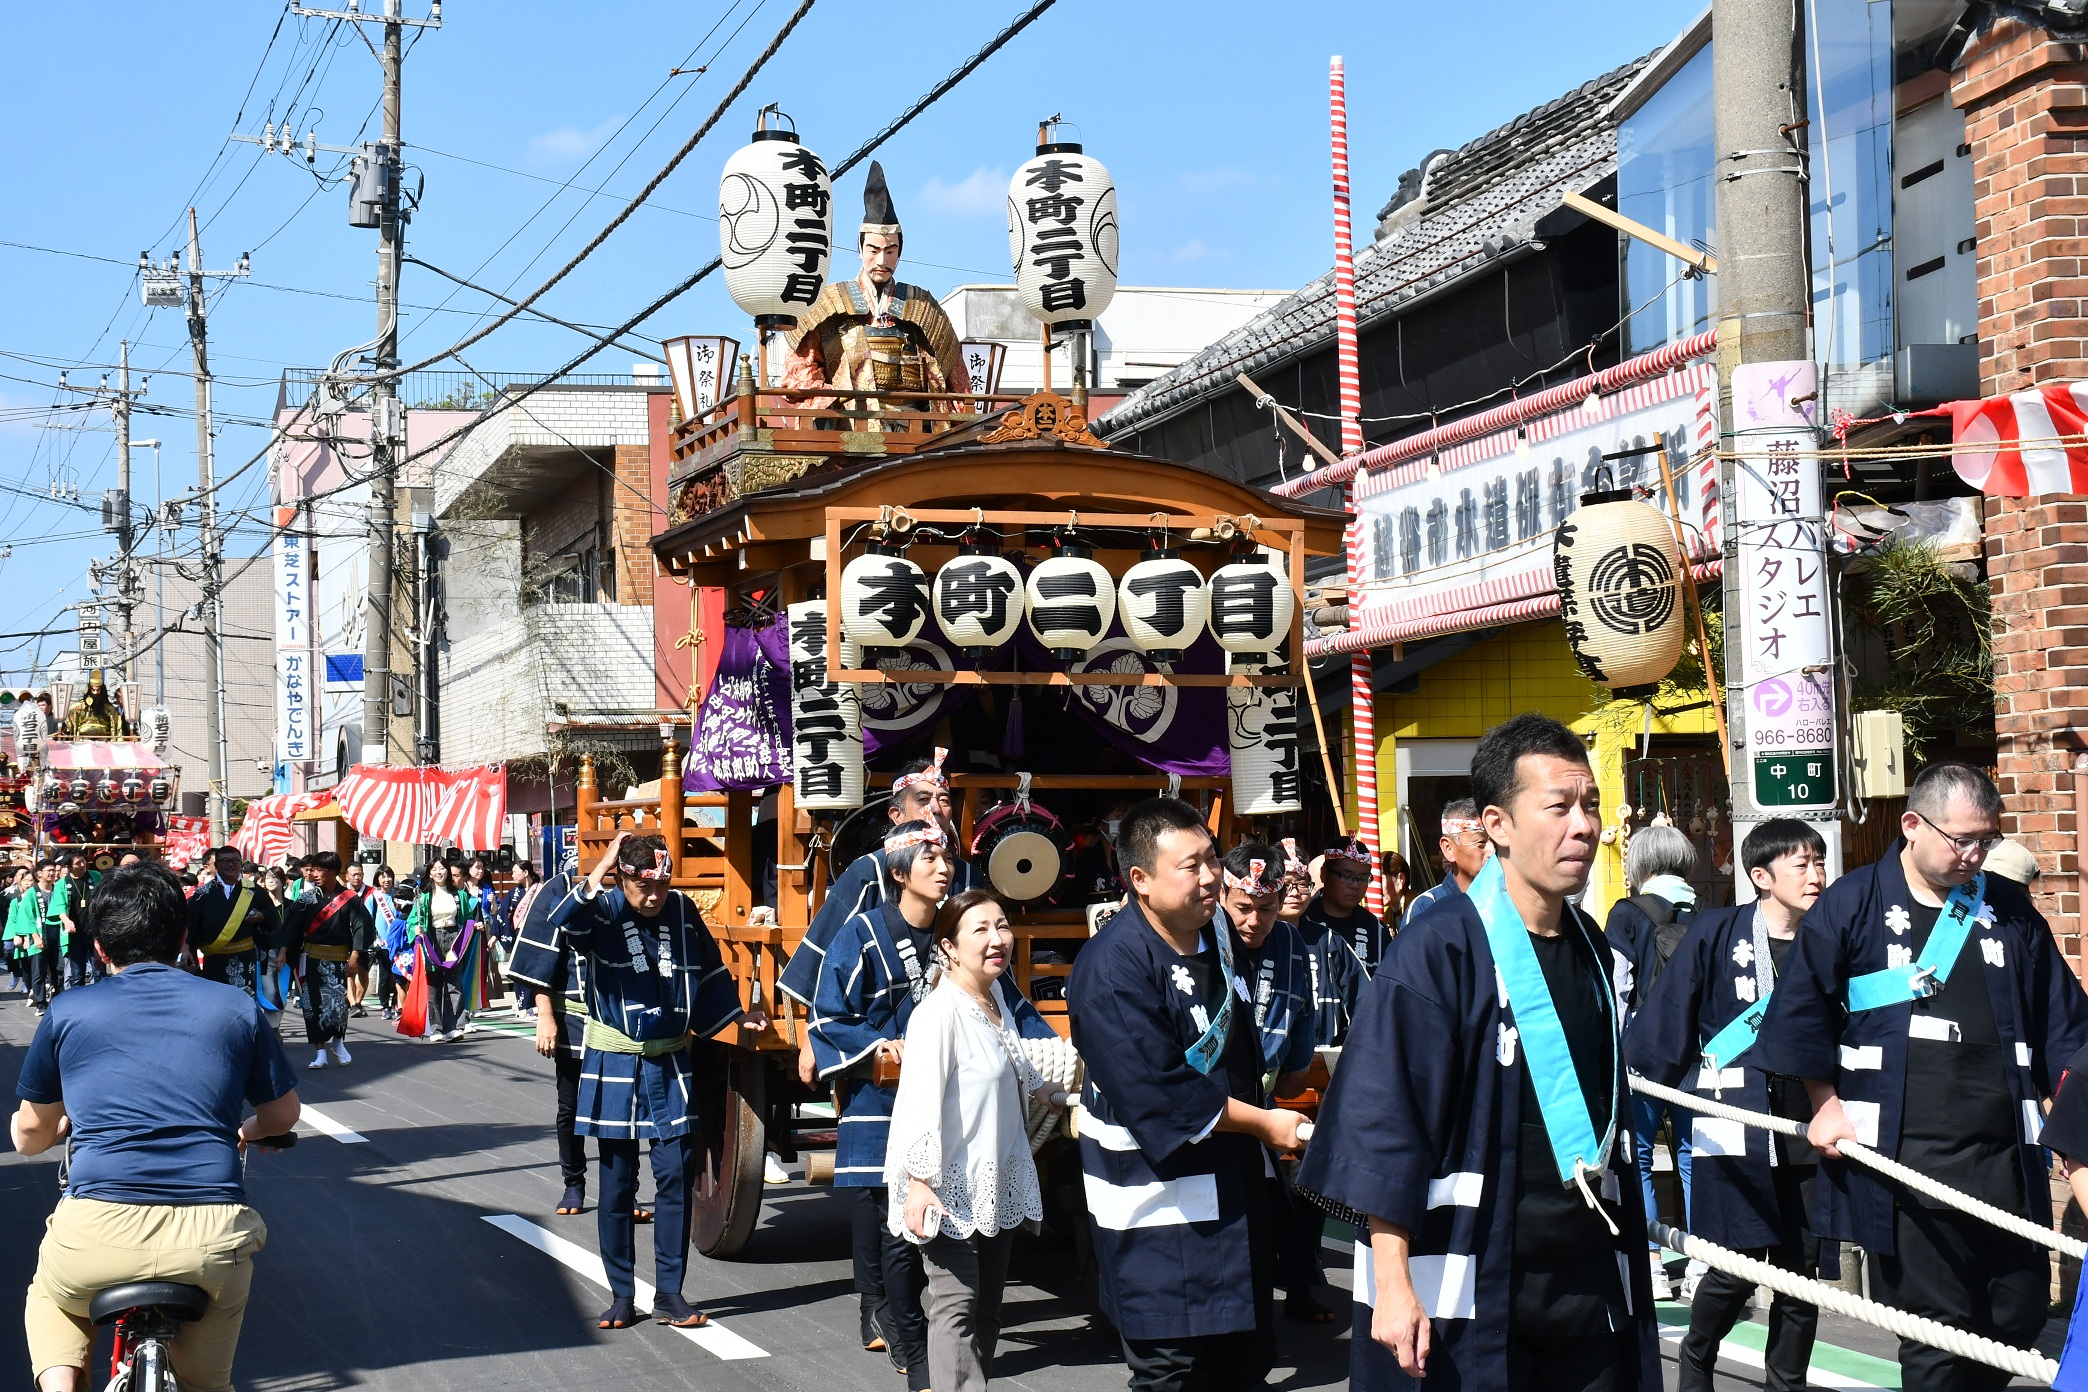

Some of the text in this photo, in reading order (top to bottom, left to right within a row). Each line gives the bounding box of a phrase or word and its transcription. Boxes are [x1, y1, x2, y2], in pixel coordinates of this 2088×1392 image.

[777, 148, 830, 306] 本町二丁目
[1025, 159, 1085, 312] 本町二丁目
[696, 344, 715, 408] 御祭礼
[1767, 440, 1821, 618] 藤沼バレエ
[283, 536, 301, 640] 東芝ストアー
[857, 560, 1278, 639] 本町二丁目
[1755, 523, 1787, 659] スタジオ
[286, 655, 304, 758] かなやでんき
[1796, 680, 1830, 695] 40m先
[1797, 697, 1830, 712] 右入る
[1259, 646, 1299, 804] 町二丁目
[1755, 727, 1831, 745] 966-8680
[1795, 719, 1831, 727] ハローバレエ
[1770, 762, 1822, 779] 中町
[1788, 783, 1809, 799] 10
[622, 921, 649, 973] 二番組
[1732, 939, 1757, 1003] 本町
